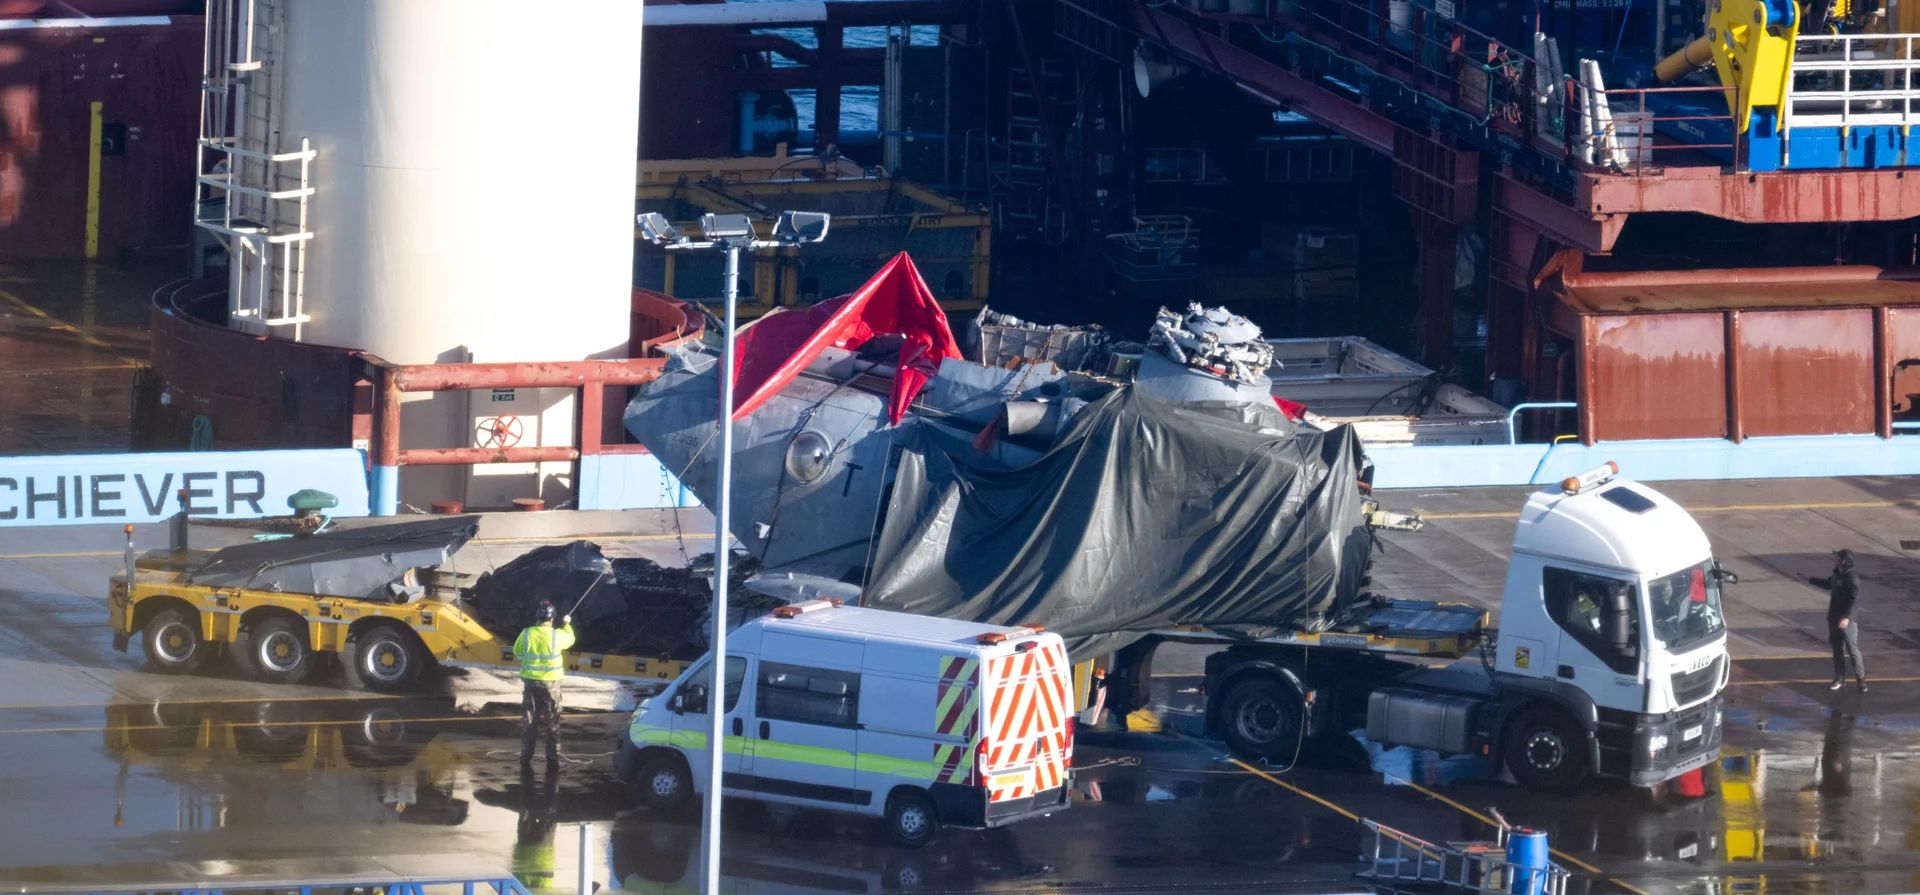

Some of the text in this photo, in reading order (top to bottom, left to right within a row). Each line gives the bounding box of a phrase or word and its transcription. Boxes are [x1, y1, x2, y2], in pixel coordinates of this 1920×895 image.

[672, 432, 698, 447] ZJ135
[844, 462, 864, 497] T
[1689, 655, 1712, 671] IVECO
